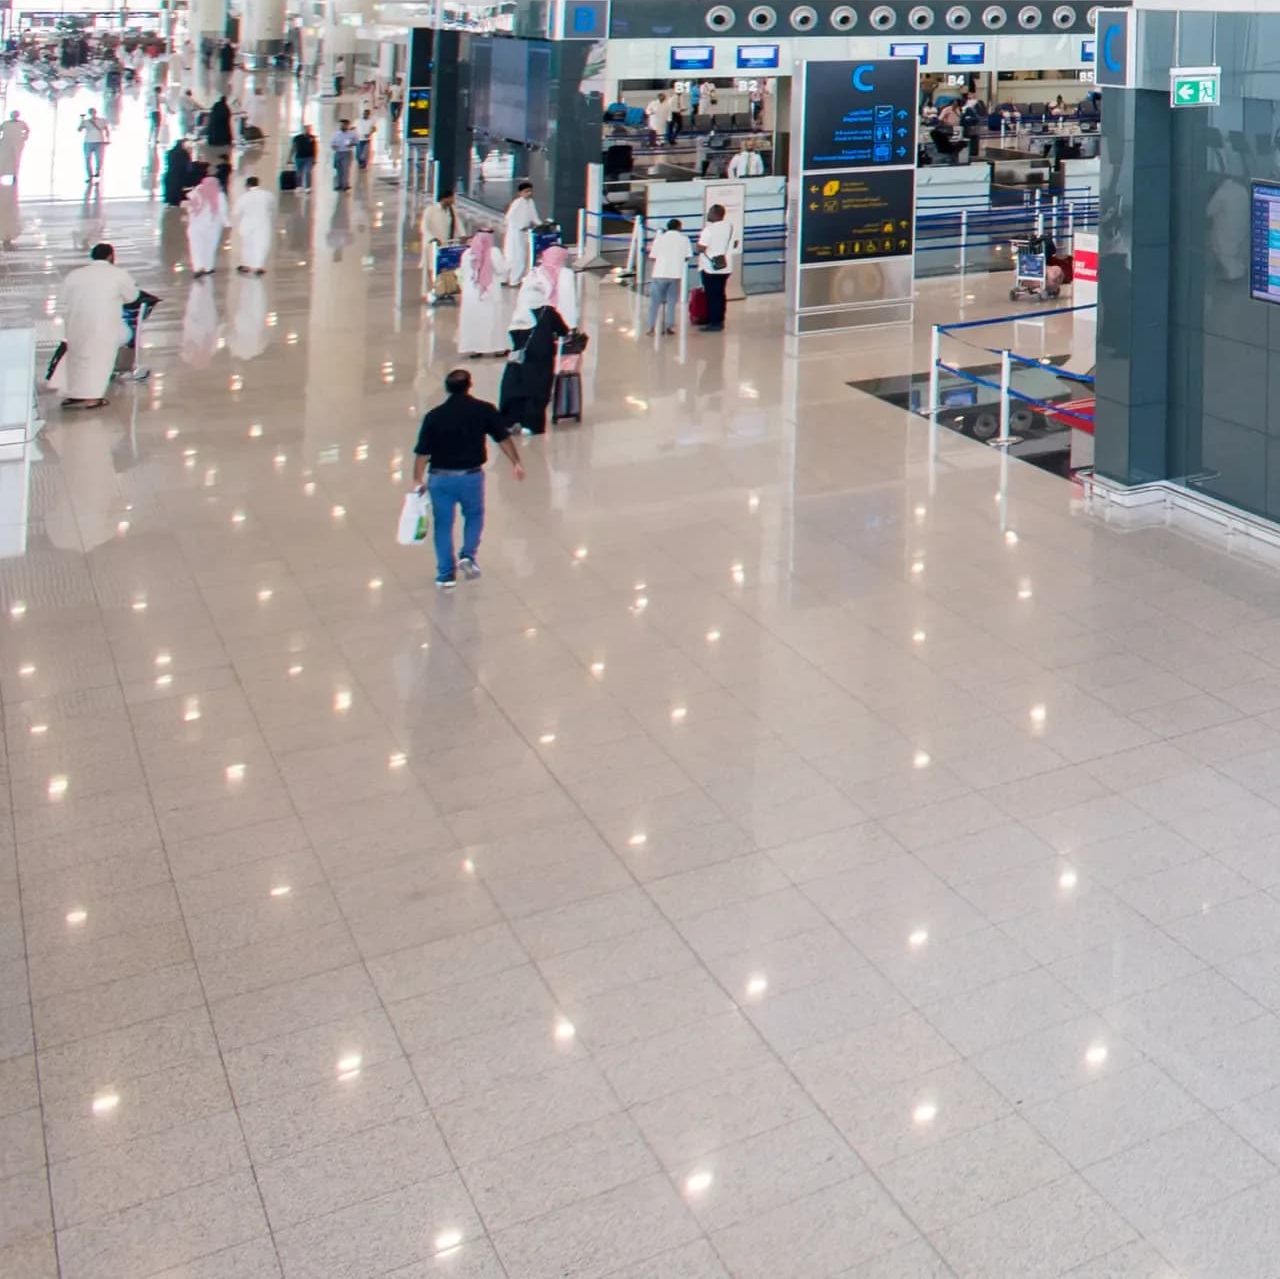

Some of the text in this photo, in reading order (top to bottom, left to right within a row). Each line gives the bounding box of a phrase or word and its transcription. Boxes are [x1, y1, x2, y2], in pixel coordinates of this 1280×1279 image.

[573, 6, 597, 33] B
[1103, 24, 1121, 71] C
[674, 81, 691, 93] B1
[737, 80, 758, 92] B2
[853, 64, 874, 91] C
[947, 75, 965, 86] B4
